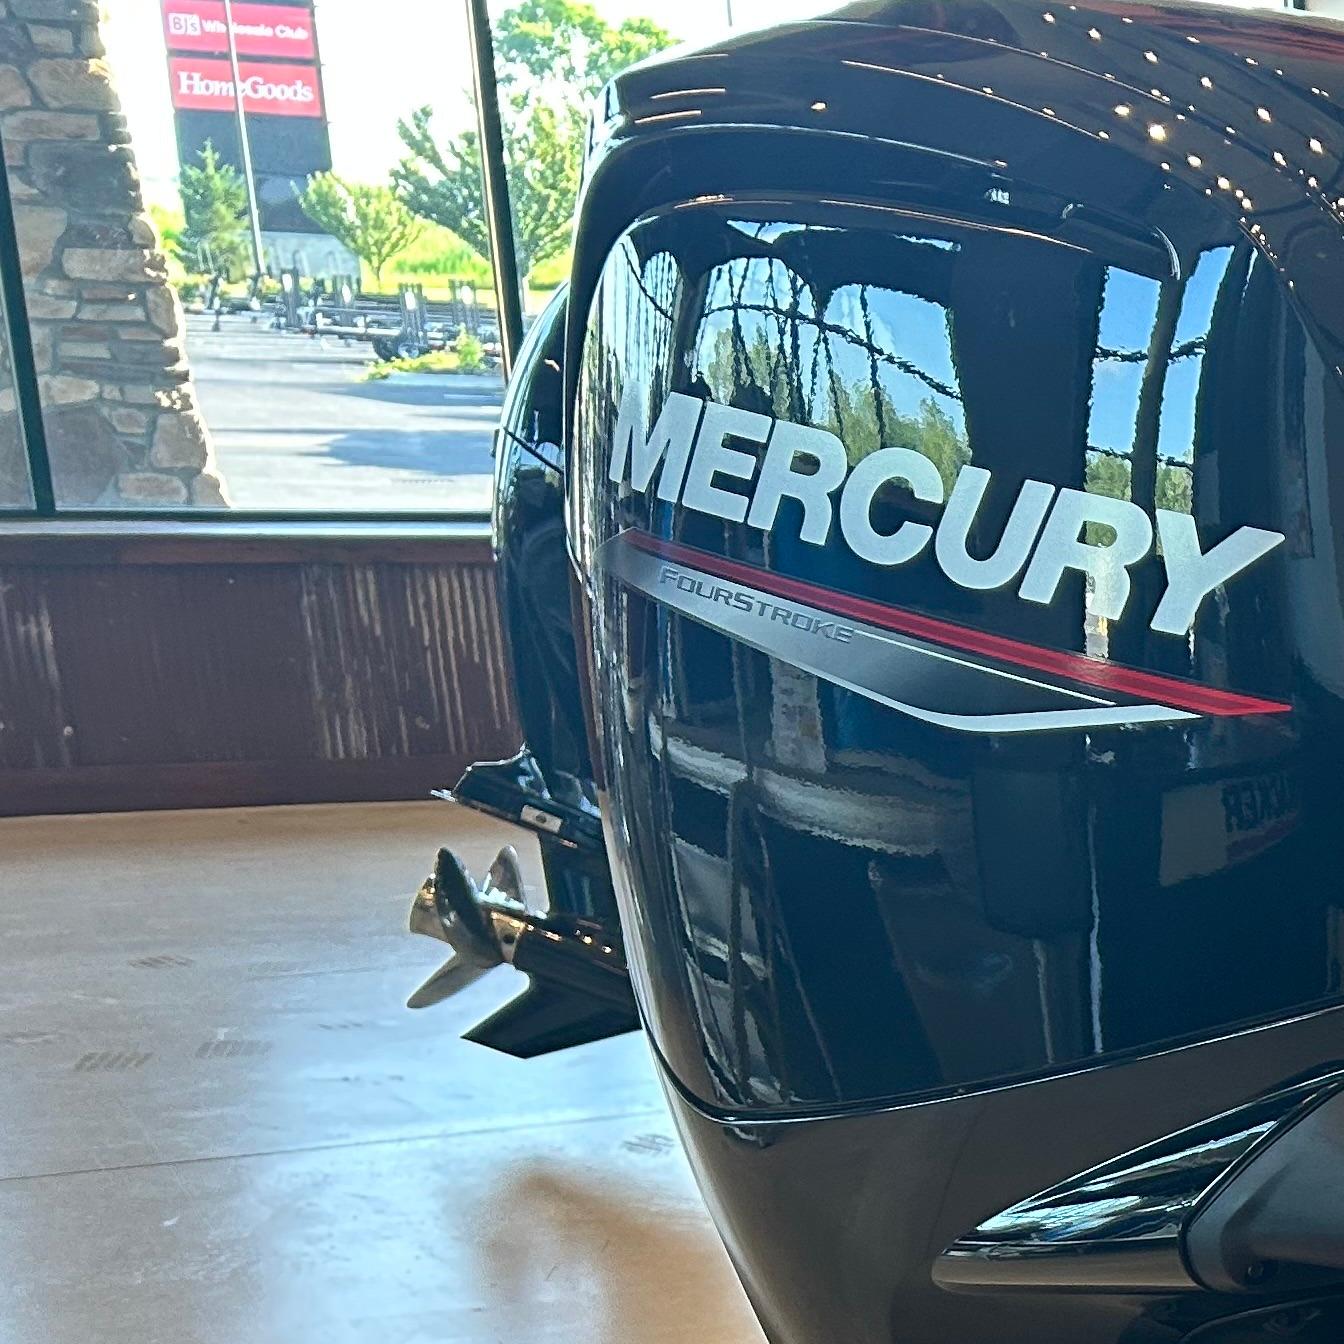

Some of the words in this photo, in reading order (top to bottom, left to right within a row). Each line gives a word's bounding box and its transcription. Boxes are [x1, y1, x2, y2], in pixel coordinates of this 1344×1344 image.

[202, 19, 273, 37] Whlesale
[608, 380, 1286, 636] MERCURY
[659, 566, 854, 644] FOURSTROKE
